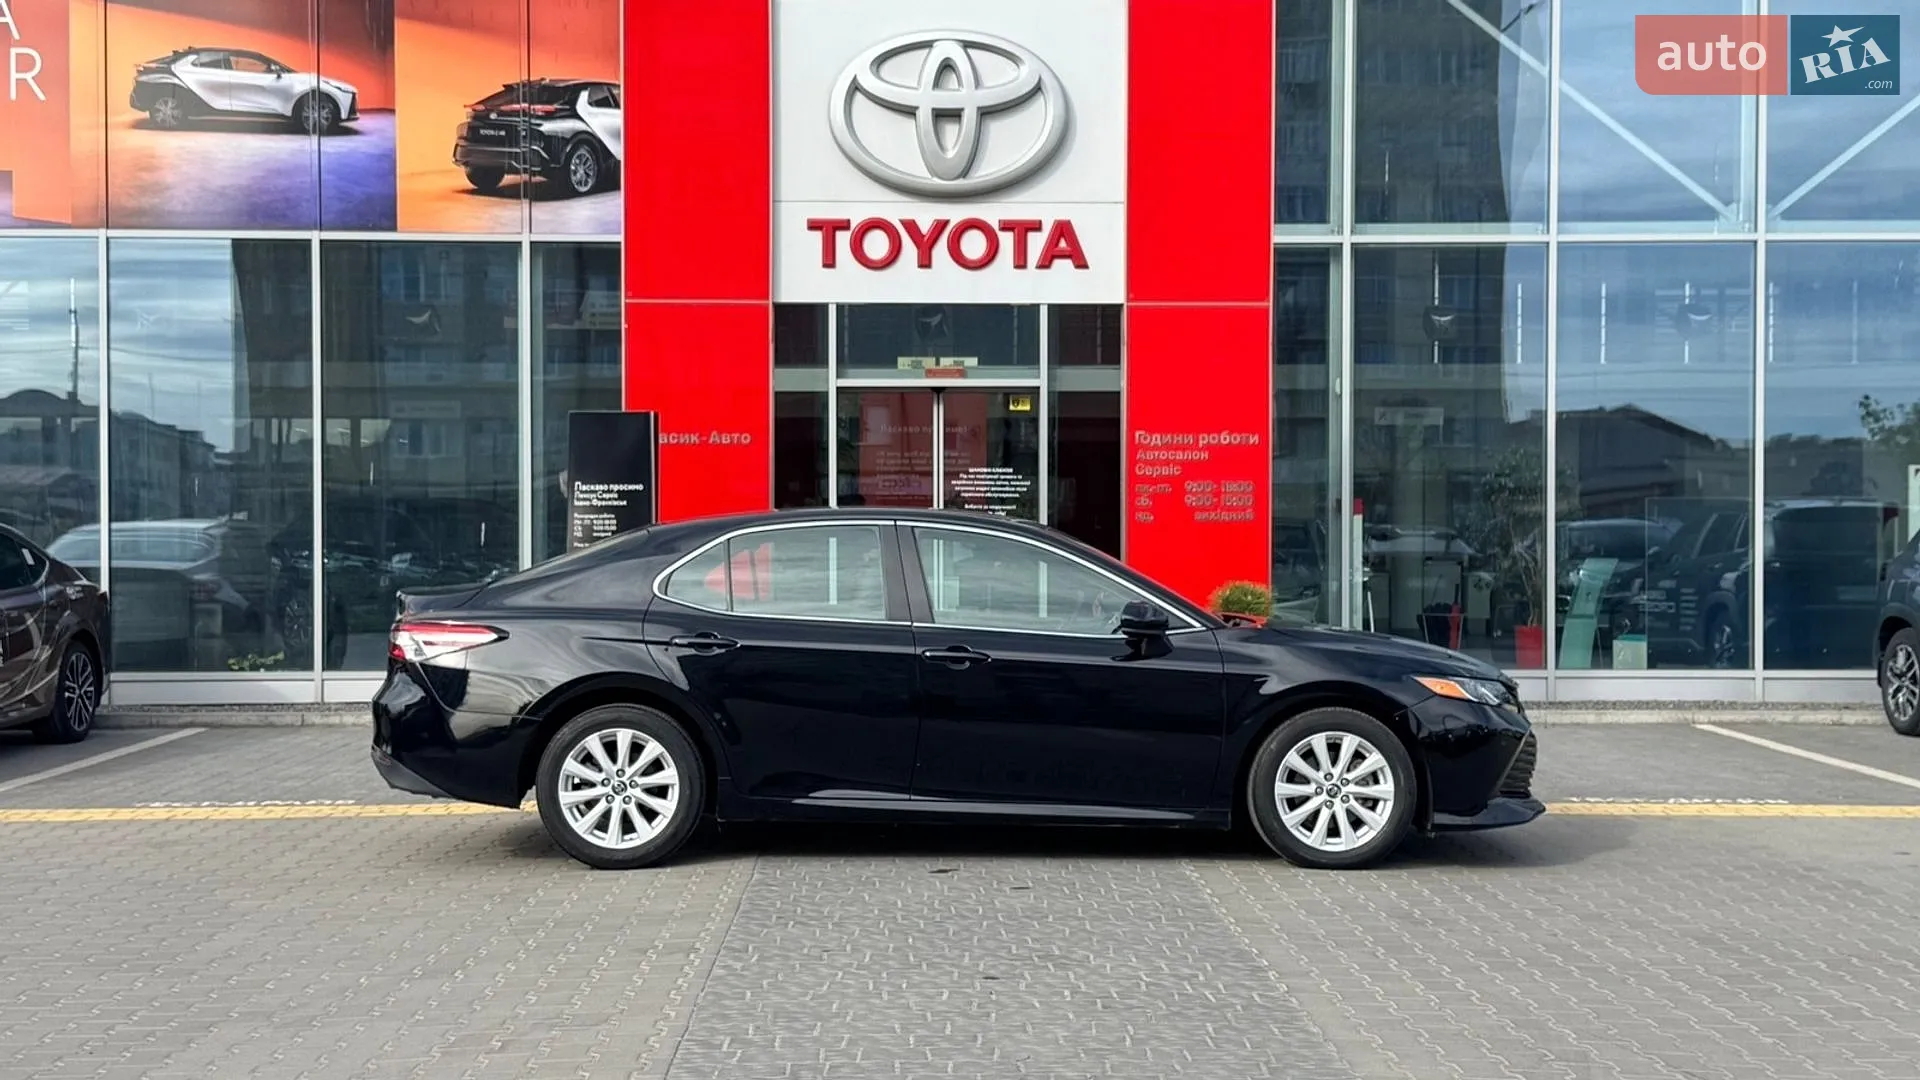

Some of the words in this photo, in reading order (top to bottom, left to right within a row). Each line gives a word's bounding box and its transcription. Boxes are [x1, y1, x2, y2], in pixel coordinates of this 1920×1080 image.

[807, 217, 1090, 270] TOYOTA
[1134, 430, 1194, 447] Години
[1198, 430, 1260, 448] роботи
[1136, 449, 1209, 461] Автосалон
[1135, 463, 1183, 477] Сервіс
[574, 481, 609, 491] Ласкаво
[609, 483, 644, 492] просимо
